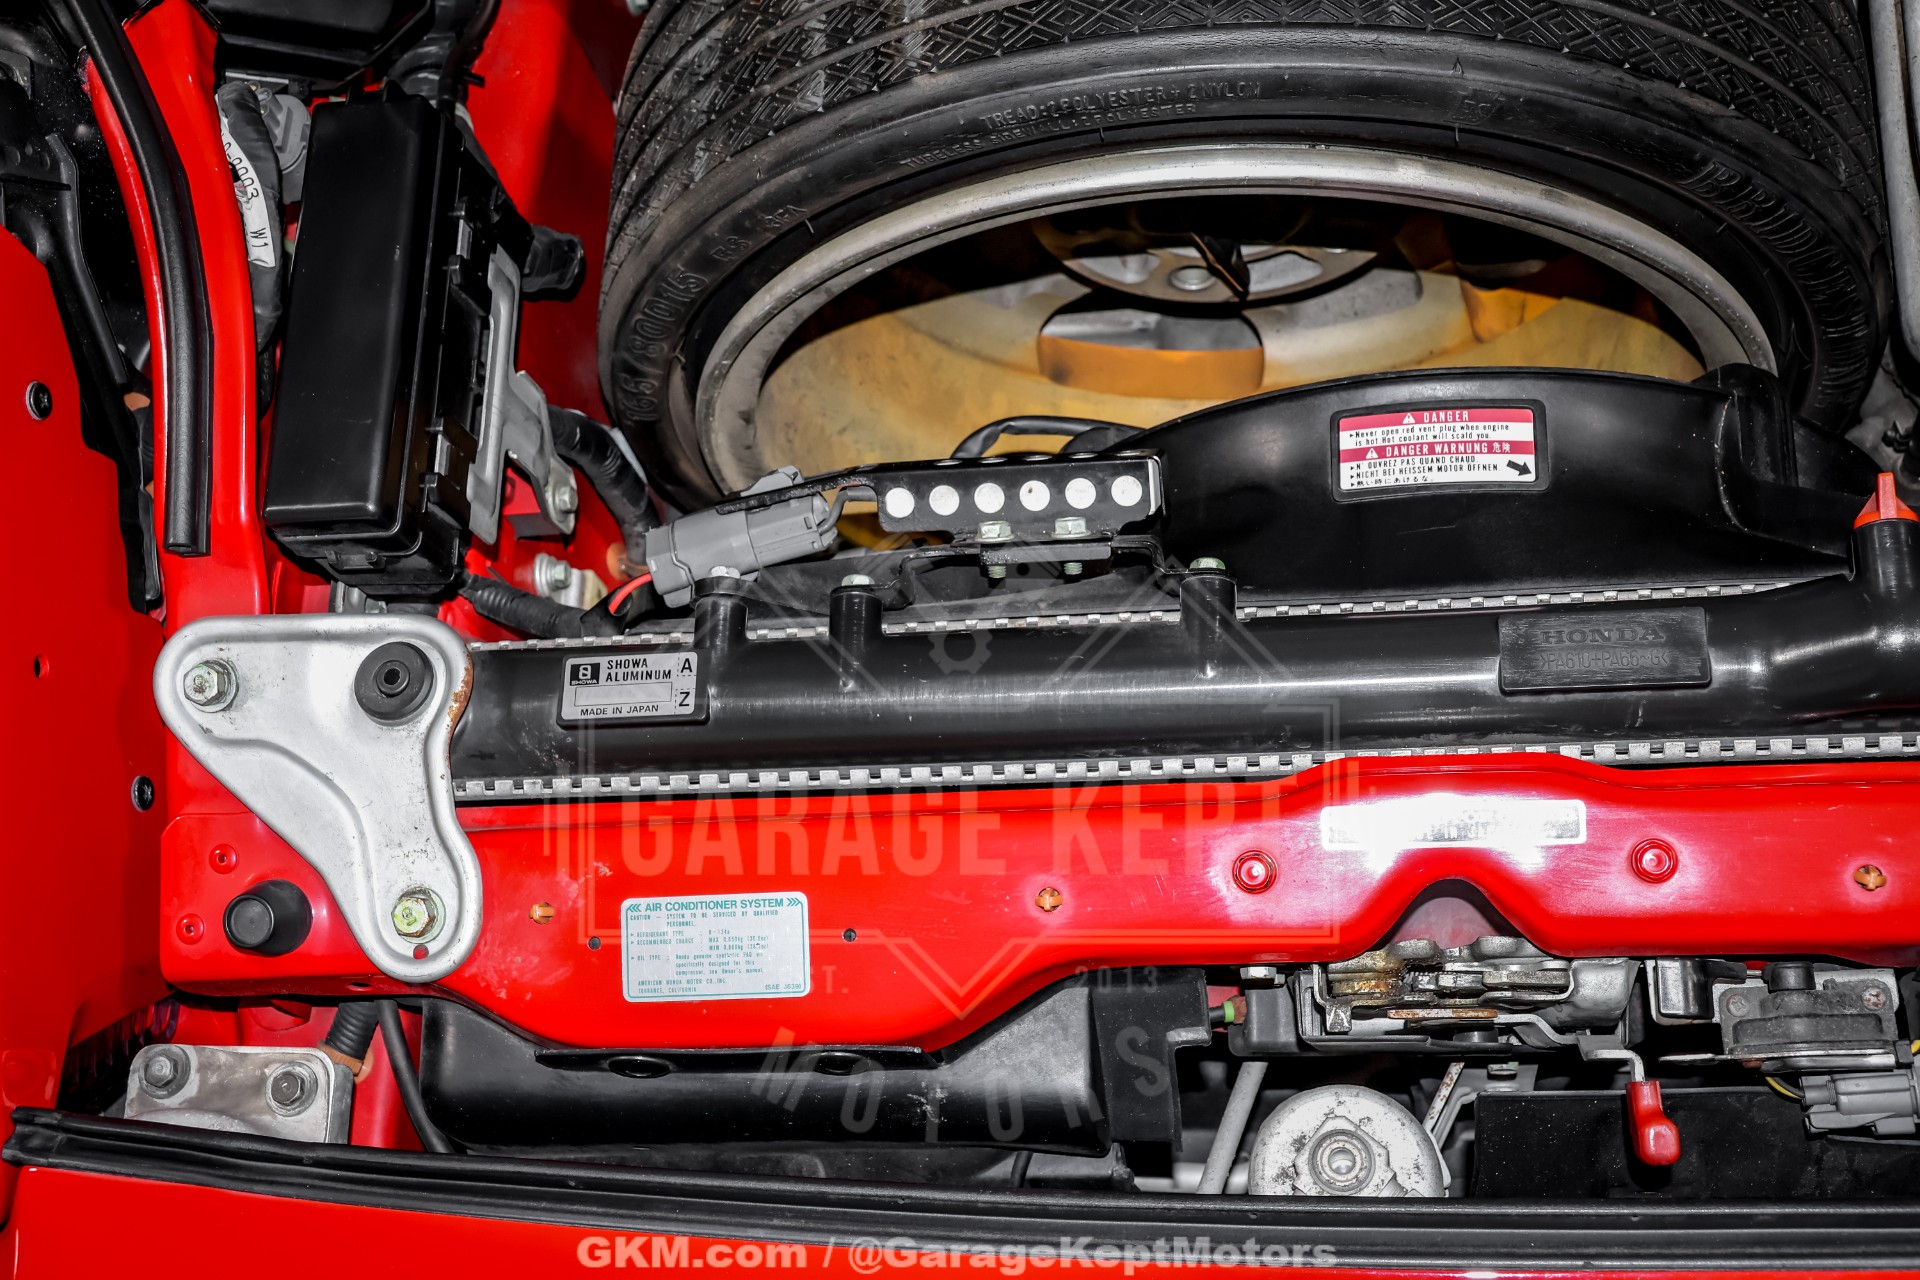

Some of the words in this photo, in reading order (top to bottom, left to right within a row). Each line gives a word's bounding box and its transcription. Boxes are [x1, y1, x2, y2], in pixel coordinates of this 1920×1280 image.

[1424, 411, 1469, 423] DANGER
[1381, 428, 1399, 437] open
[1440, 424, 1456, 433] plug
[1483, 424, 1509, 432] engine
[1399, 433, 1428, 442] coolant
[1386, 444, 1429, 457] DANGER
[1434, 443, 1488, 454] WARNUNG
[1492, 442, 1510, 453] 危険
[1368, 460, 1397, 469] OUVREZ
[1356, 470, 1378, 479] NICHT
[1383, 468, 1396, 476] BEI
[1399, 466, 1433, 475] HEISSEM
[1540, 628, 1666, 644] HONDA
[607, 658, 648, 670] SHOWA
[680, 658, 693, 673] A
[605, 670, 672, 682] ALUMINUM
[678, 692, 690, 707] Z
[580, 708, 608, 716] MADE
[627, 705, 658, 714] JAPAN
[645, 903, 662, 912] AIR
[665, 900, 737, 911] CONDITIONER
[740, 898, 784, 908] SYSTEM
